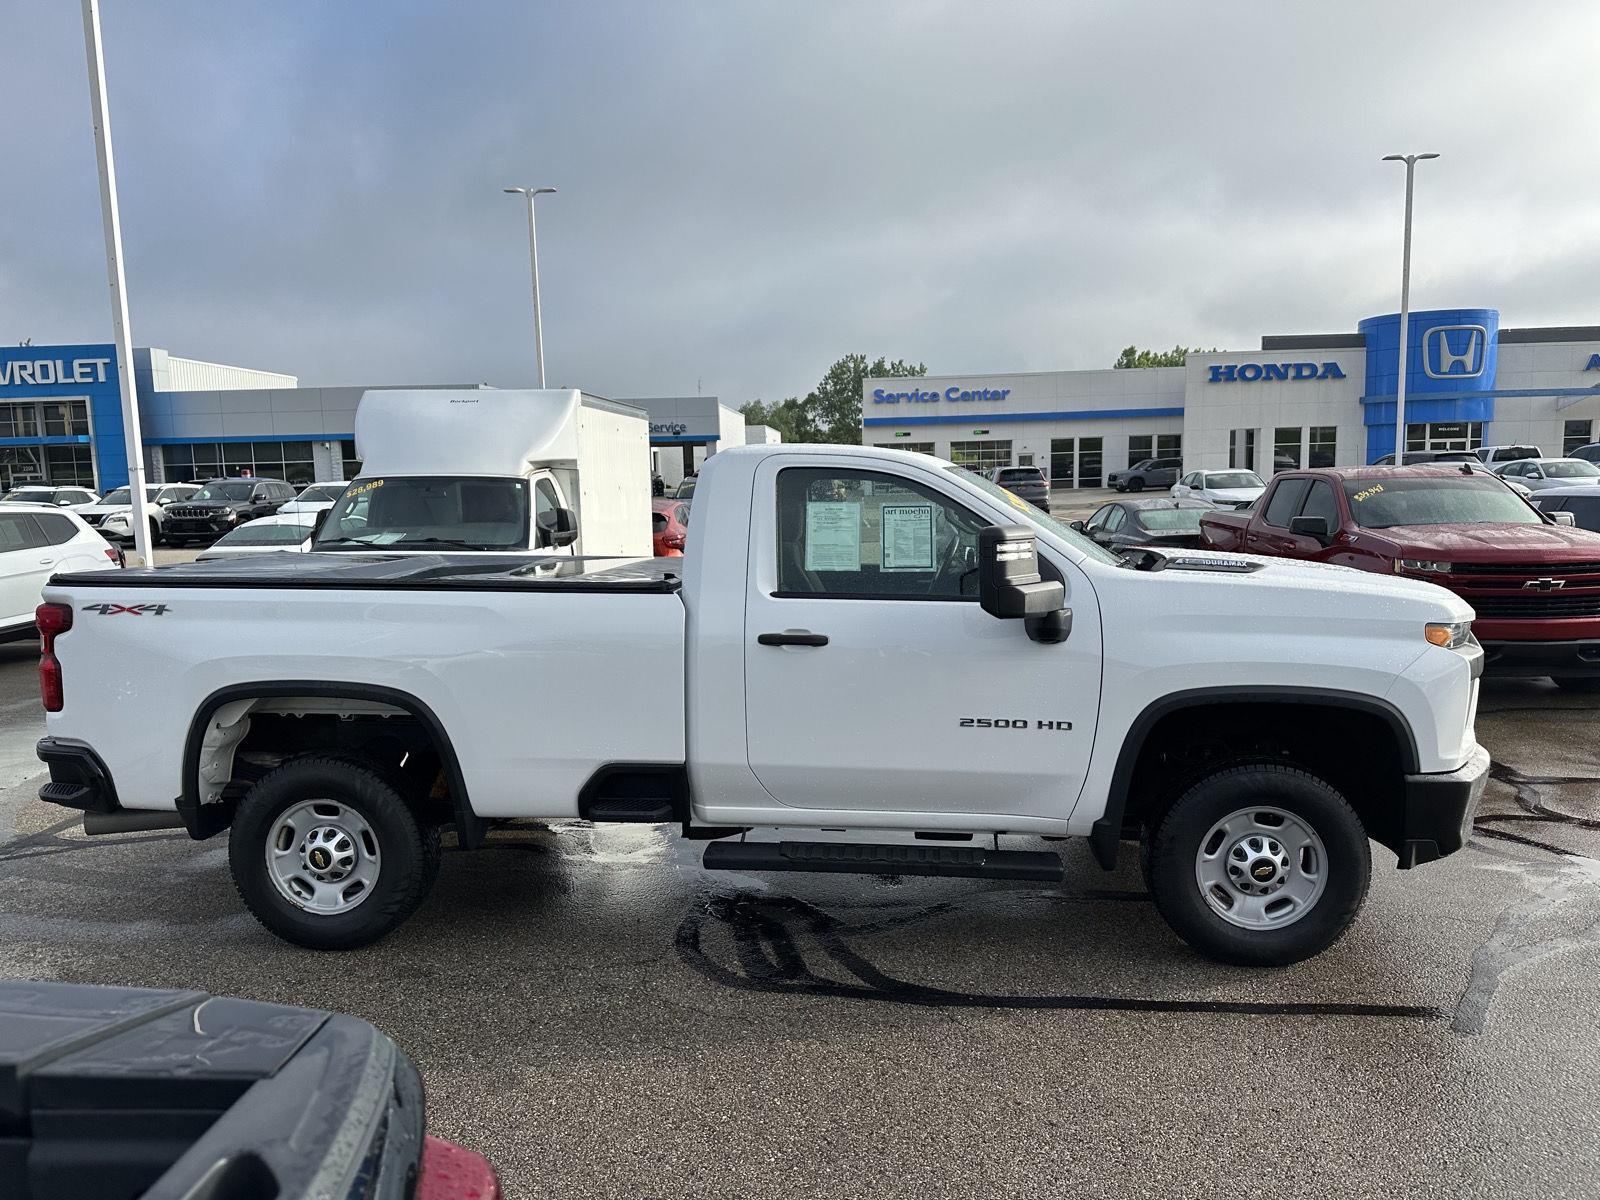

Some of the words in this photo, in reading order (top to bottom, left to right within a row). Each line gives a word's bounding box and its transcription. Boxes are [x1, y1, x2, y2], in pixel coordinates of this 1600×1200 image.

[1208, 361, 1347, 383] HONDA
[873, 388, 940, 404] Service
[945, 387, 1011, 402] Center
[649, 421, 687, 433] Service
[959, 718, 1028, 729] 2500
[1037, 720, 1073, 731] HD
